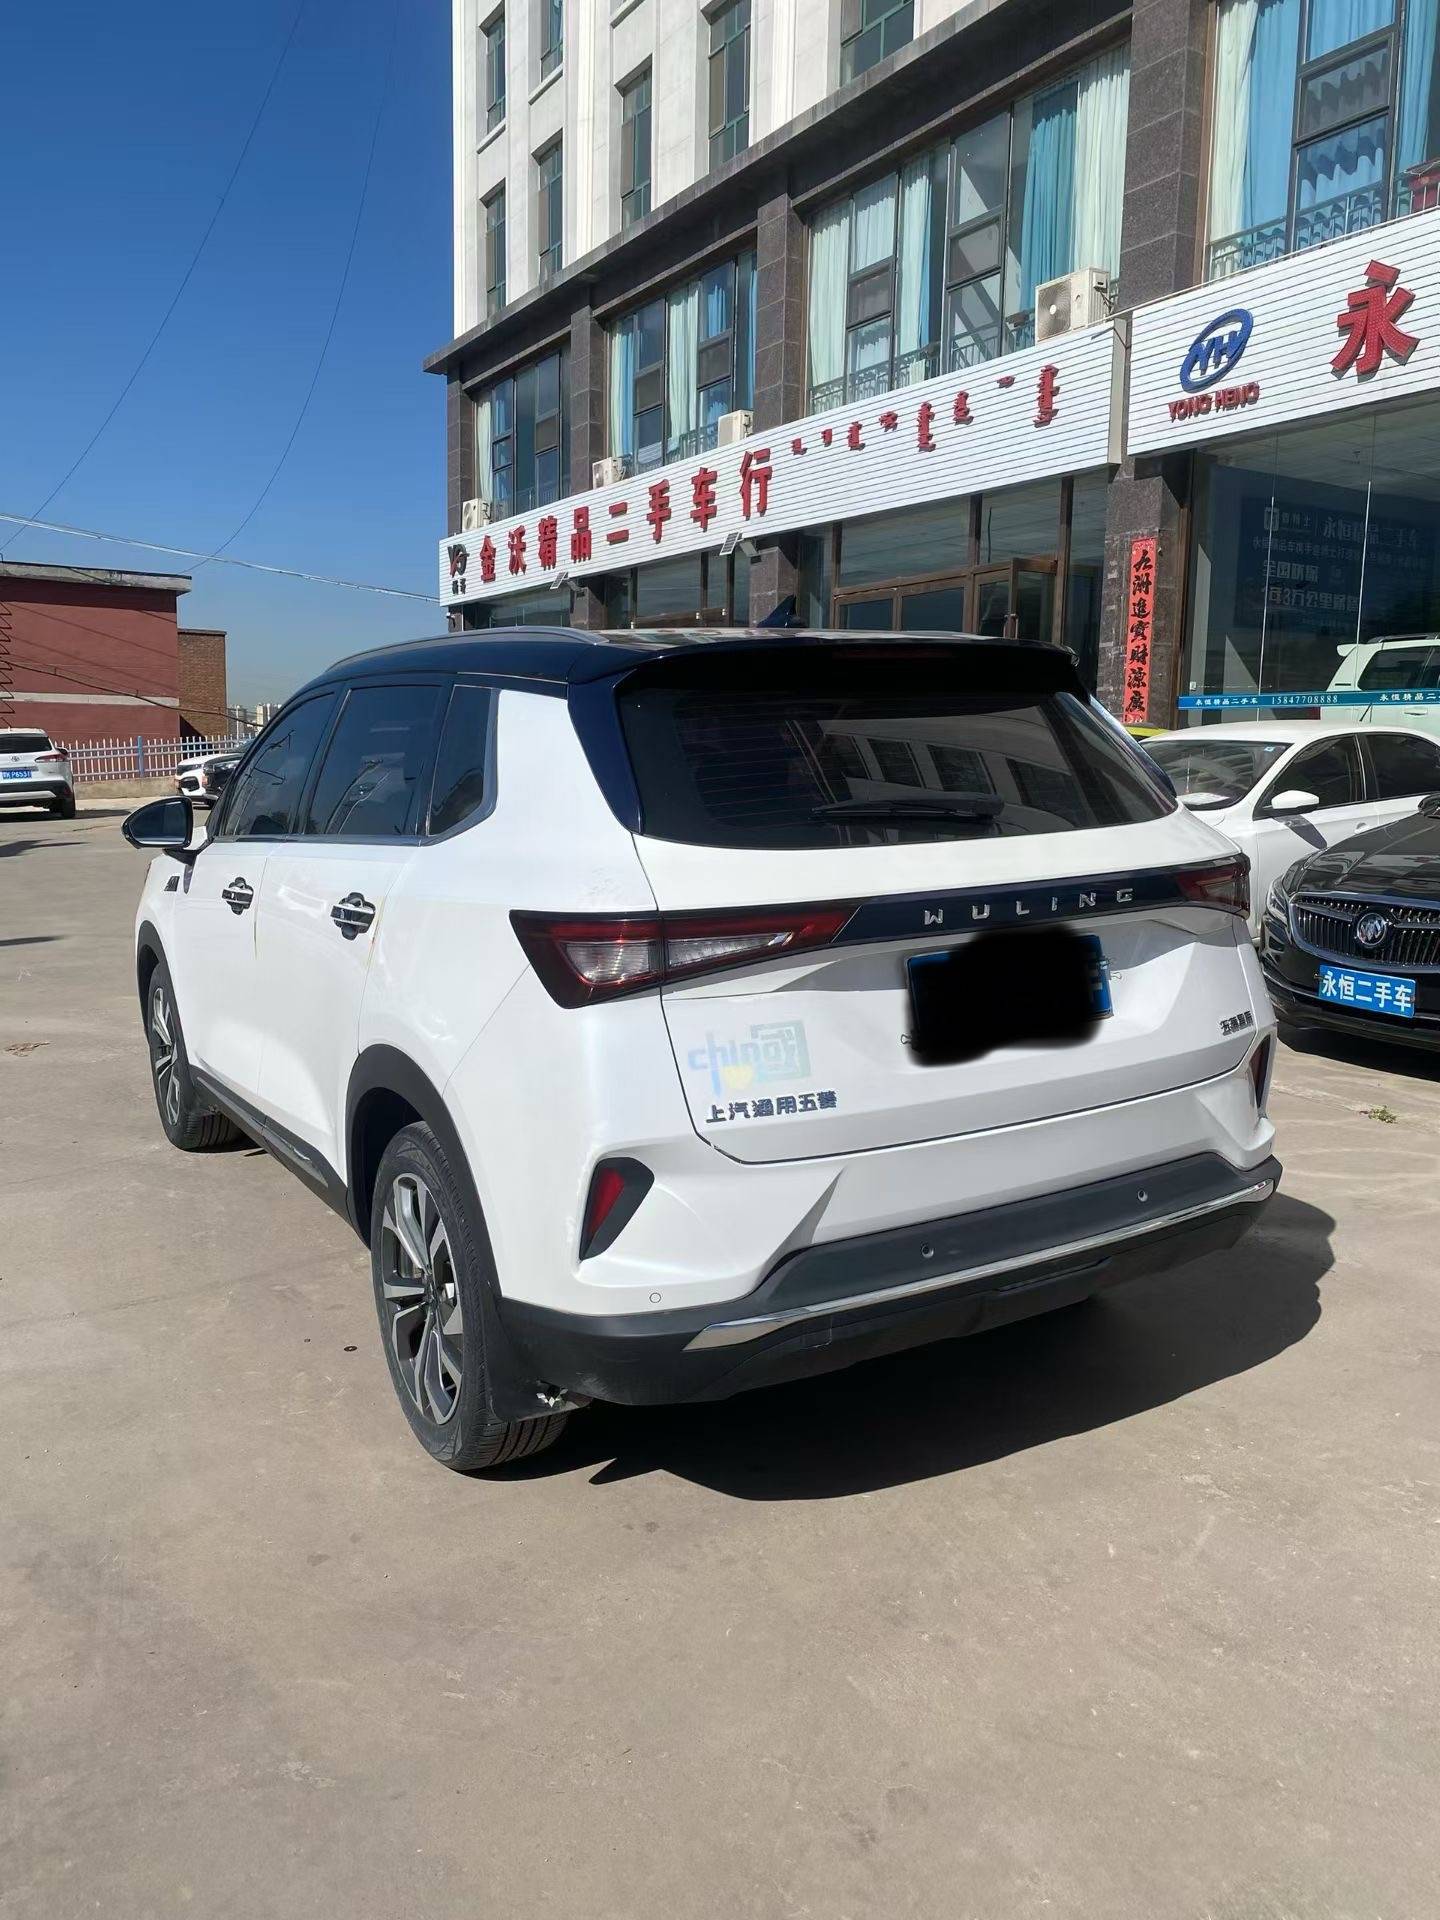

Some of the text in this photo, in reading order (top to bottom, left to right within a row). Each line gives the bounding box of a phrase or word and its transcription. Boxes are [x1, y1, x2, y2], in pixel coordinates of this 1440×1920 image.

[1330, 259, 1420, 383] 永
[1168, 381, 1260, 423] YONG HENG
[479, 448, 773, 584] 金沃精品二手车行
[1271, 694, 1338, 704] 15847708888
[1380, 692, 1440, 702] 永恒精品二
[924, 887, 1133, 926] WULING
[1321, 970, 1412, 1013] 永恒二手车
[705, 1090, 838, 1124] 上汽通用五菱
